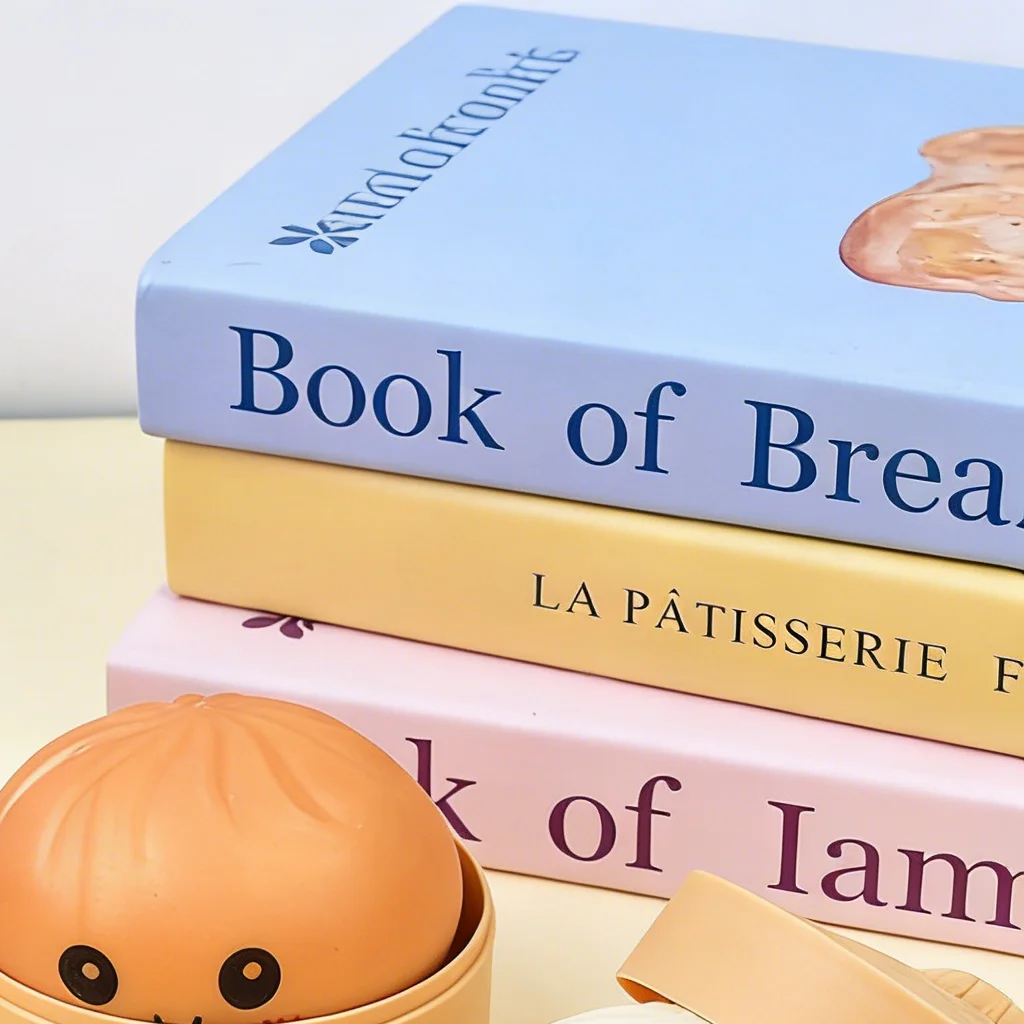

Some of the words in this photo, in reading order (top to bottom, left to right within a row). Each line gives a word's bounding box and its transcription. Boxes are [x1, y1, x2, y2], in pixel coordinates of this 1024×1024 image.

[229, 326, 504, 452] Book
[567, 381, 687, 476] of
[741, 400, 1024, 529] Brea
[532, 572, 602, 619] LA
[623, 587, 948, 682] PÂTISSERIE
[405, 738, 481, 843] k
[548, 776, 681, 872] of
